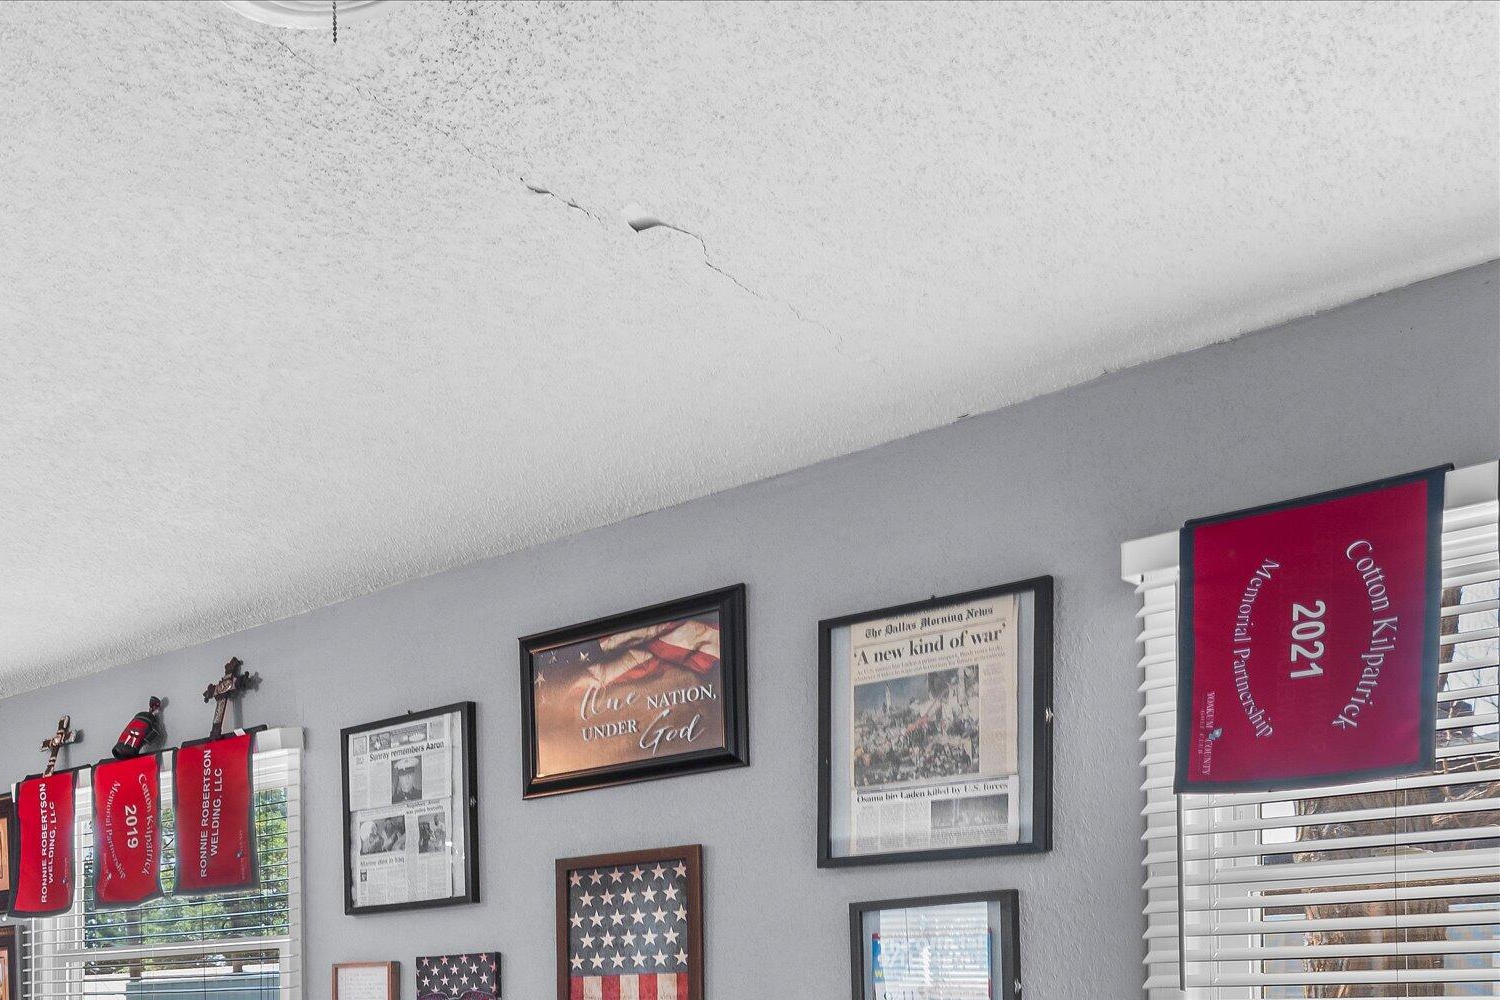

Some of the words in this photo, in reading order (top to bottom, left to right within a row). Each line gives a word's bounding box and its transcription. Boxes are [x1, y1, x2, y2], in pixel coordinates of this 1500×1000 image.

[1347, 540, 1390, 611] Cotton
[865, 628, 882, 639] The
[884, 622, 916, 636] Dallas
[919, 612, 964, 630] Morning
[965, 606, 993, 621] News
[1234, 558, 1280, 642] Memorial
[874, 648, 904, 663] new
[909, 634, 944, 657] kind
[950, 630, 968, 649] of
[1290, 600, 1326, 678] 2021
[1233, 648, 1274, 739] Partnership
[1332, 616, 1398, 731] Kilpatrick
[580, 685, 636, 720] One
[646, 684, 716, 709] NATION,
[1205, 692, 1215, 728] YOAKUM
[370, 751, 389, 761] Sunray
[390, 745, 424, 757] remembers
[426, 740, 444, 751] Aaron
[582, 720, 637, 741] UNDER
[640, 709, 703, 756] God
[214, 768, 222, 792] LLC
[1202, 739, 1213, 775] COUNTY
[106, 780, 121, 826] Memorial
[138, 773, 152, 812] Cotton
[201, 750, 212, 826] ROBERTSON
[856, 794, 884, 804] Osama
[886, 793, 898, 801] bin
[900, 790, 925, 800] Laden
[927, 786, 949, 798] killed
[952, 786, 961, 795] by
[39, 783, 48, 856] ROBERTSON
[125, 804, 139, 848] 2019
[141, 816, 154, 876] Kilpatrick
[200, 831, 208, 877] RONNIE
